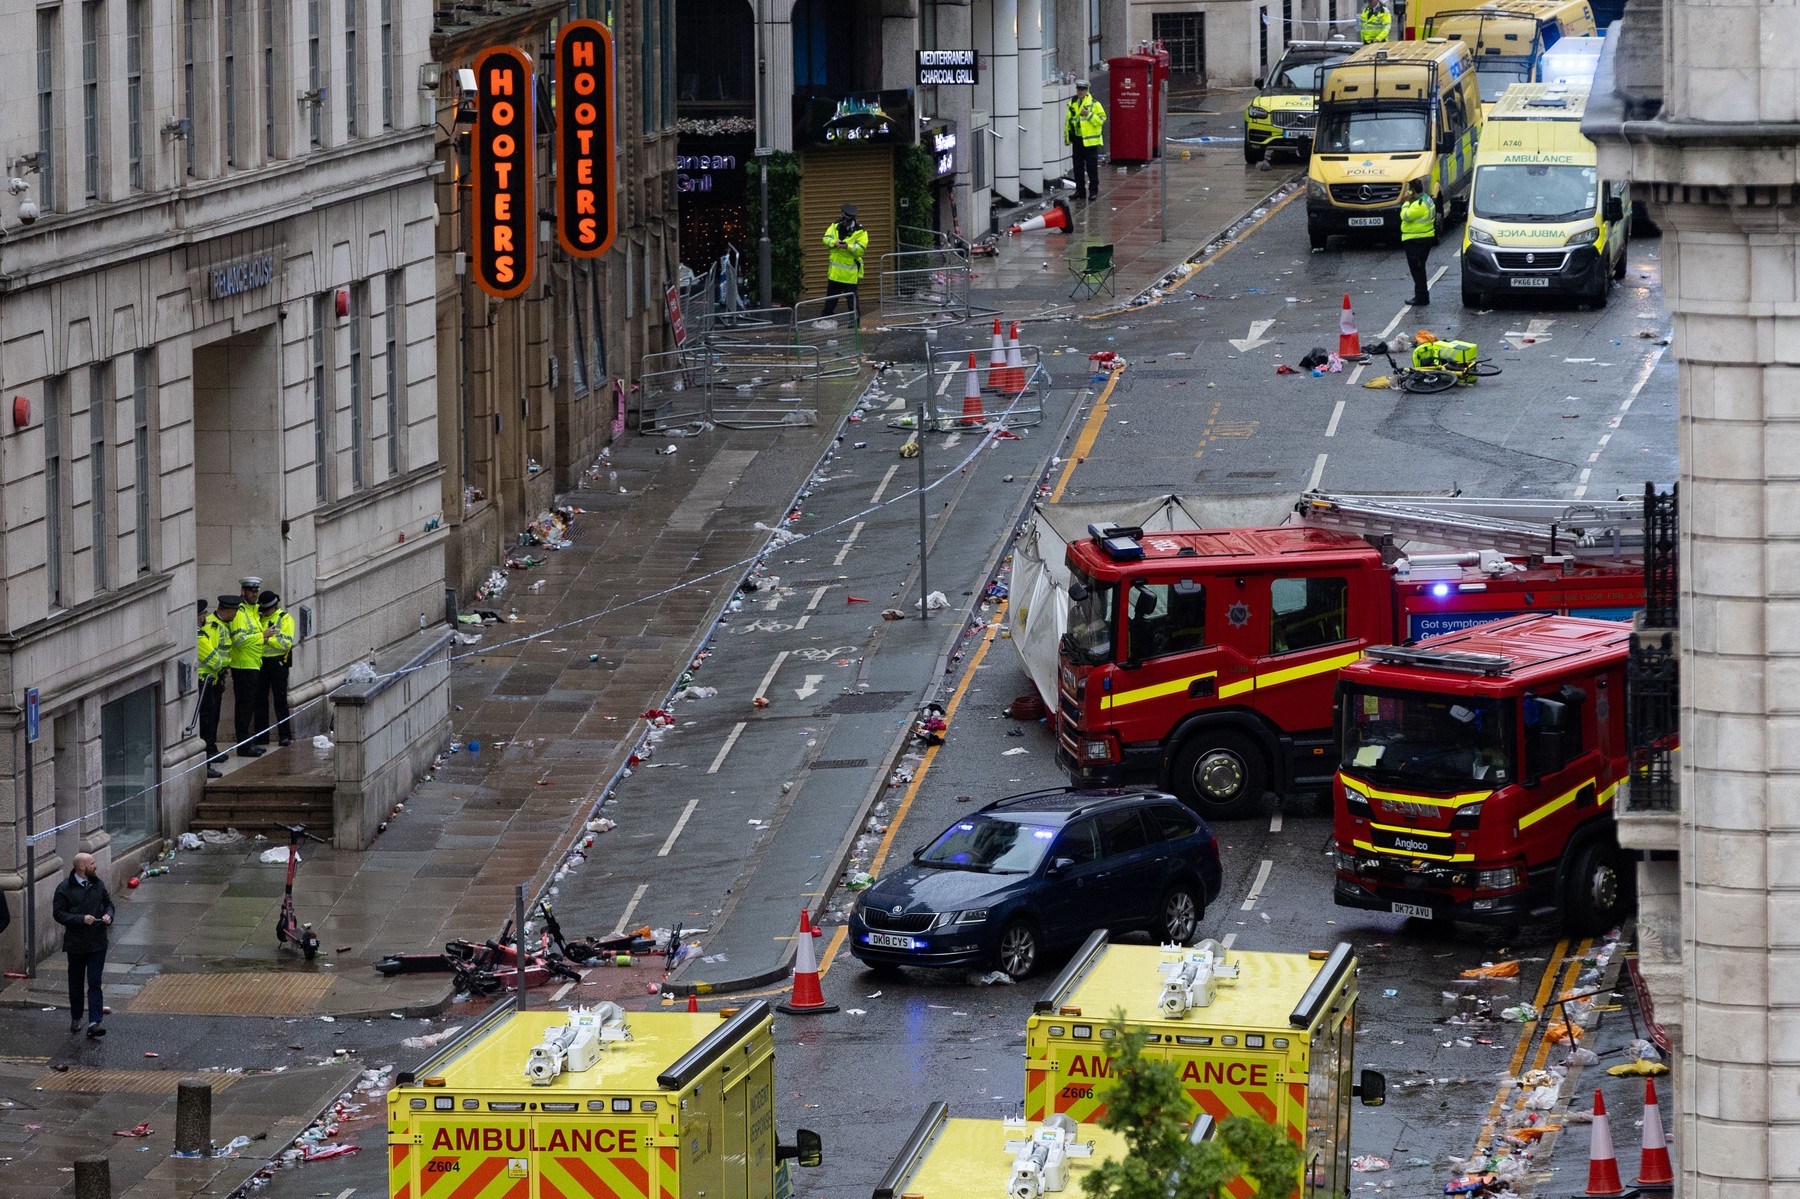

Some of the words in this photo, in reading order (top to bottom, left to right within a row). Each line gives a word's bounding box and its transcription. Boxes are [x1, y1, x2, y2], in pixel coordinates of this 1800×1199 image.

[920, 51, 974, 65] MEDITERRANEAN
[921, 69, 955, 84] CHARCOAL
[955, 69, 975, 84] GRILL
[572, 41, 597, 244] HOOTERS
[1504, 155, 1573, 163] AMBULANCE
[490, 69, 516, 283] HOOTERS
[1421, 620, 1440, 629] Got
[1381, 799, 1441, 819] SCANIA
[1395, 837, 1428, 851] Angloco
[1394, 901, 1414, 915] DK72
[1415, 905, 1430, 917] AVU
[873, 935, 890, 944] DK18
[892, 937, 908, 947] CYS
[1067, 1054, 1268, 1087] AMANCE
[1062, 1087, 1094, 1099] Z606
[432, 1127, 638, 1153] AMBULANCE
[428, 1161, 461, 1173] Z604
